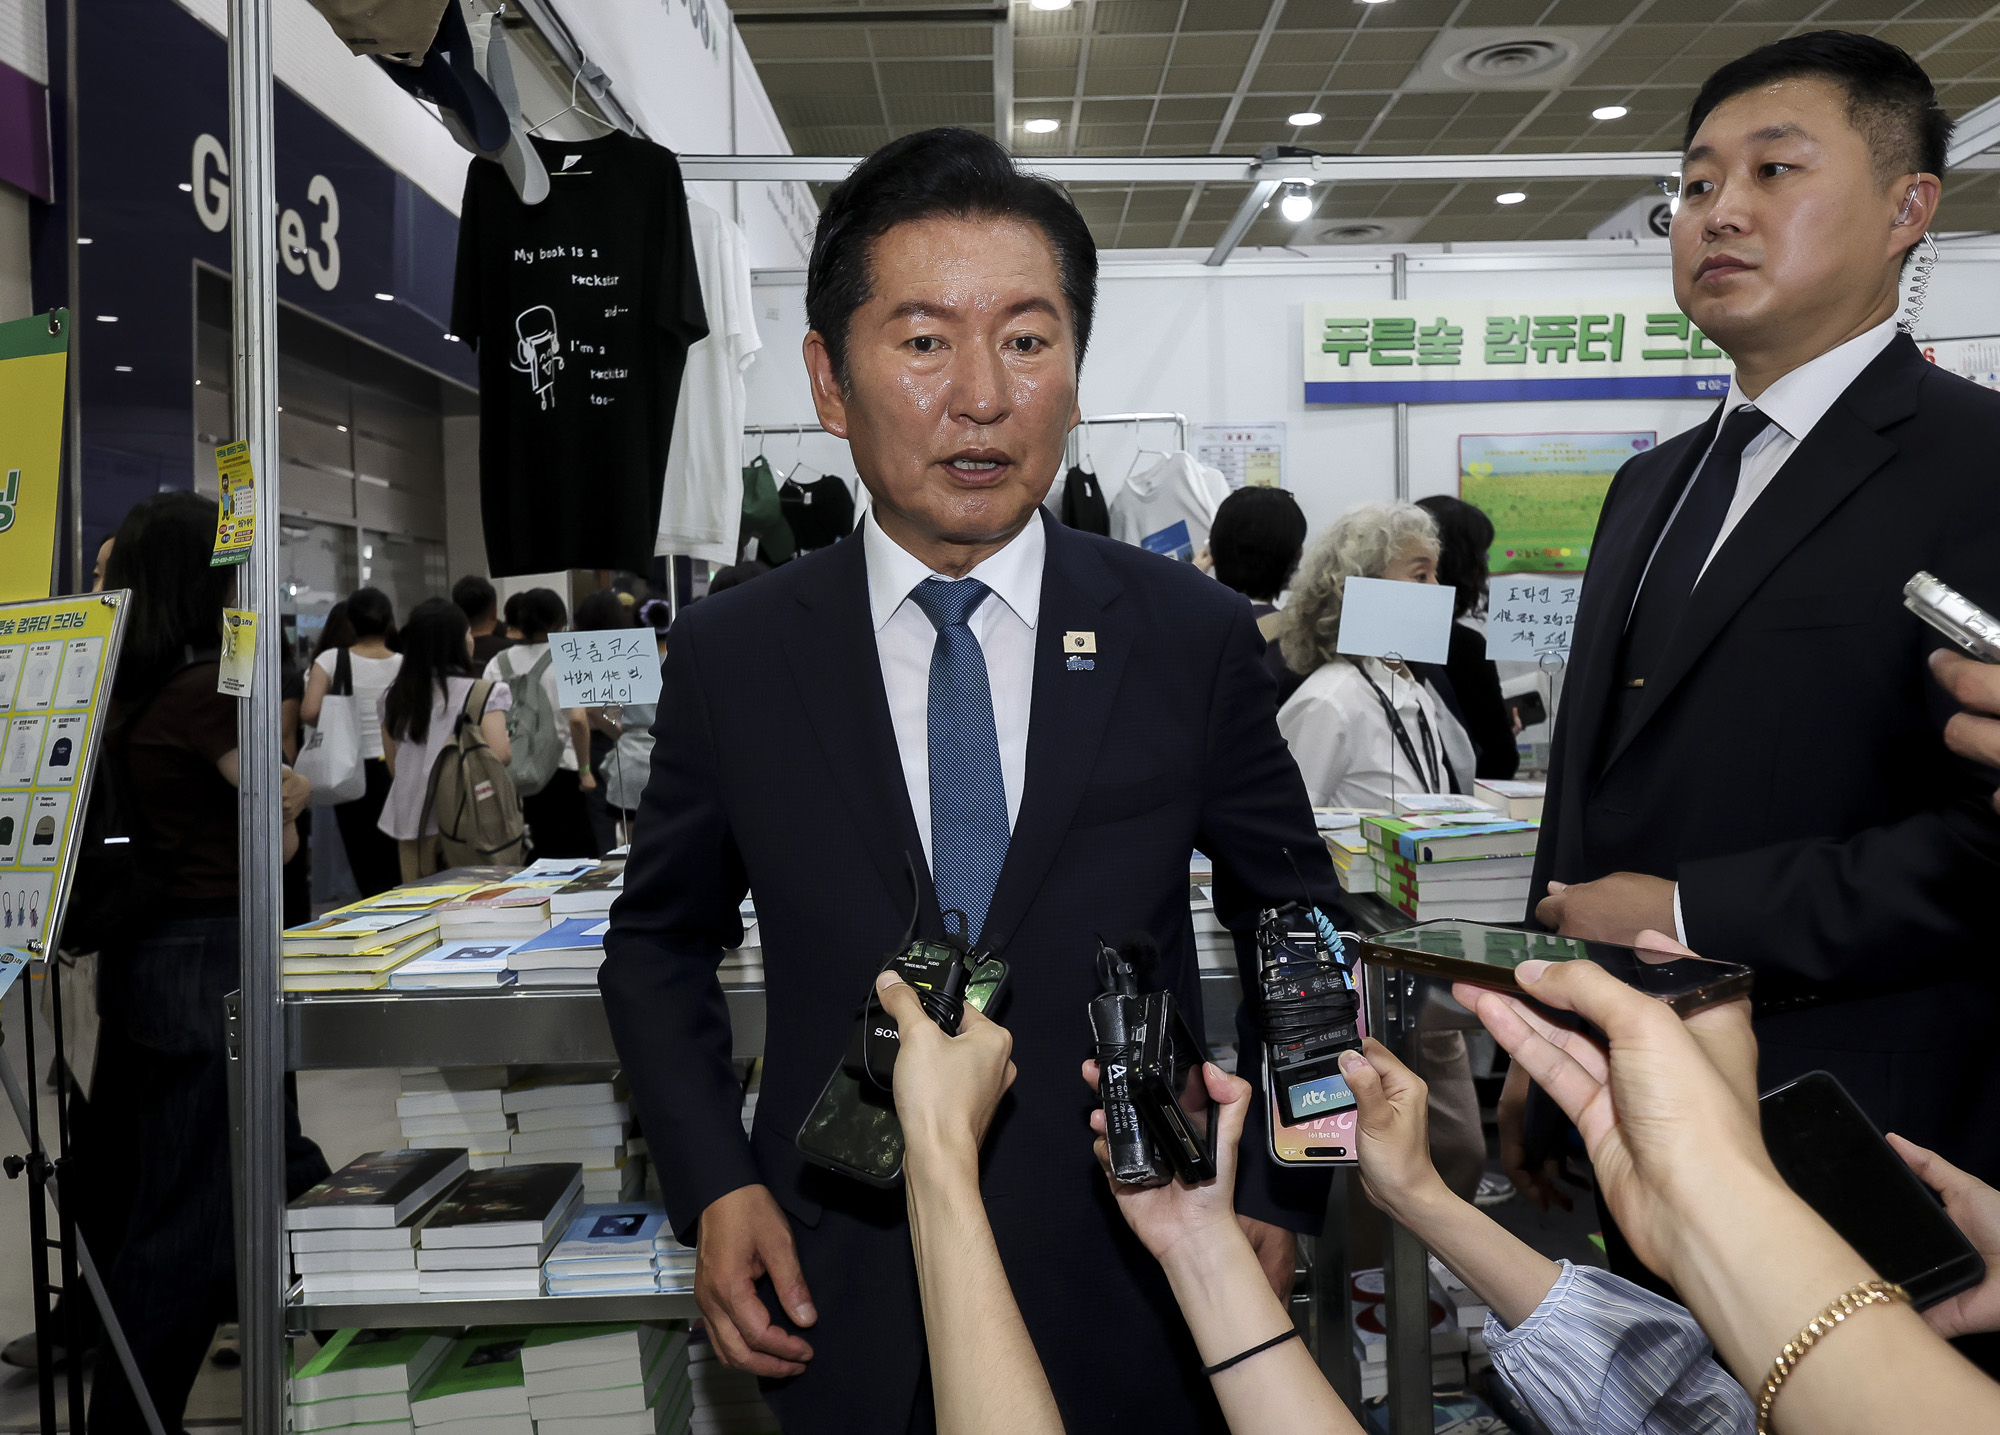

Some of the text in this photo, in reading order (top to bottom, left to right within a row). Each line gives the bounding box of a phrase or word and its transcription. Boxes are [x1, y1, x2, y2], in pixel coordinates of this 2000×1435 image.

[514, 249, 534, 264] My
[539, 246, 566, 260] book
[591, 249, 599, 258] a
[1322, 315, 1463, 366] 푸른숲
[1484, 313, 1626, 364] 컴퓨터
[599, 346, 605, 355] a
[16, 614, 51, 634] 컴퓨터
[50, 611, 88, 632] 크리닝
[600, 669, 622, 682] 사는
[581, 683, 632, 703] 에세이
